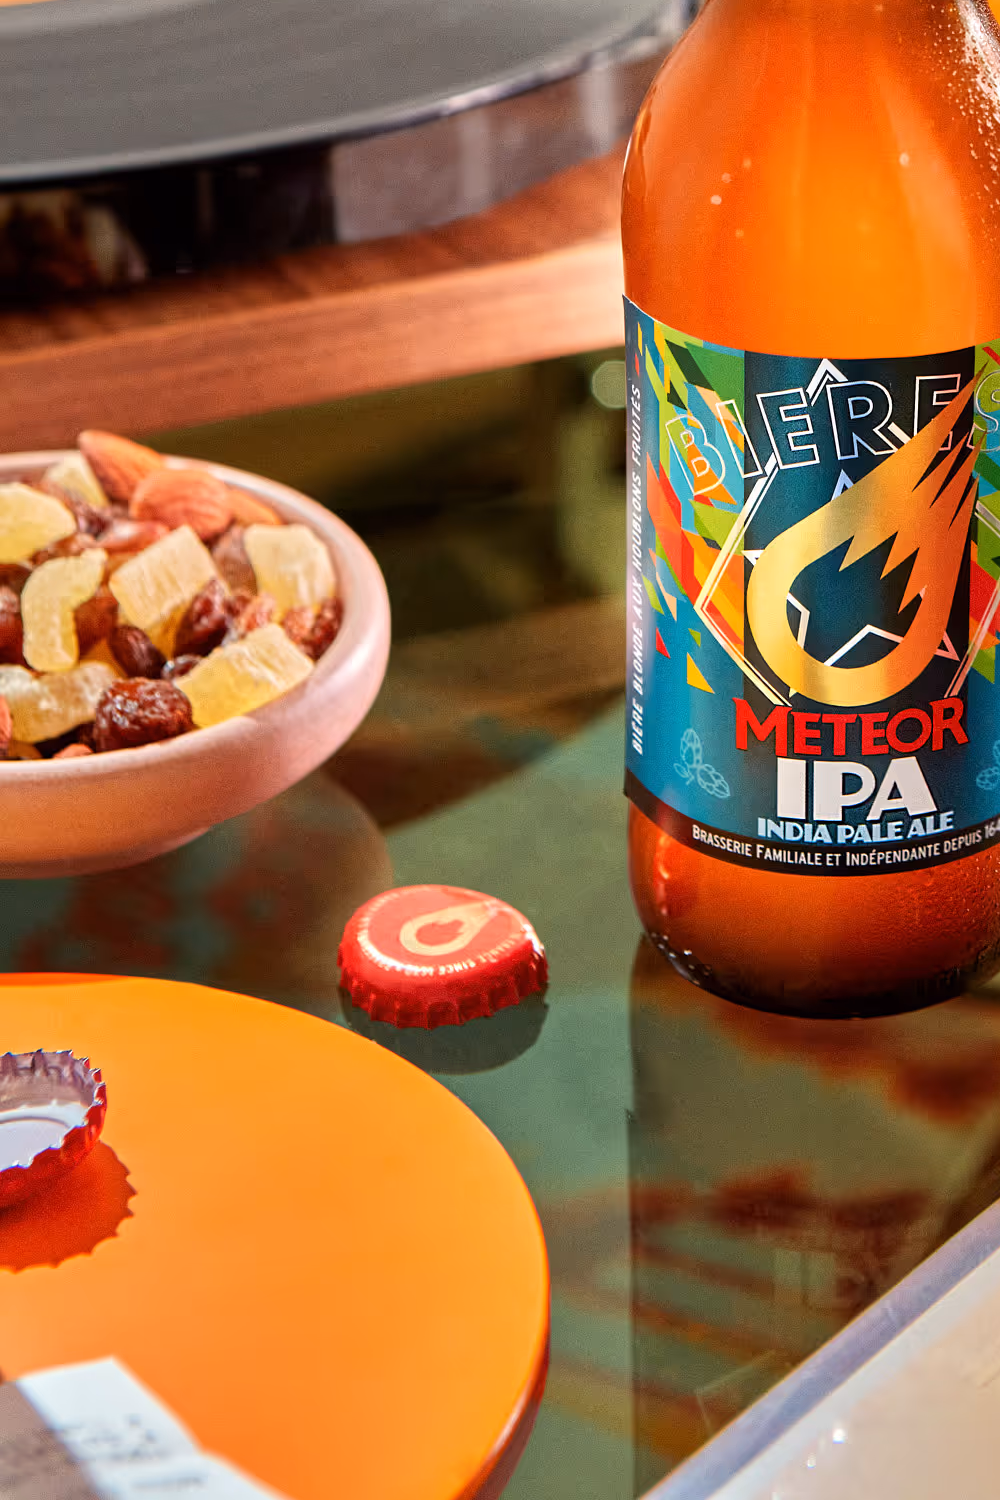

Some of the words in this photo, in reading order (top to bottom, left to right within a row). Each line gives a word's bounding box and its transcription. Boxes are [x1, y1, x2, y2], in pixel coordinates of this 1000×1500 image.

[631, 472, 643, 571] HOUBLONS
[632, 576, 643, 619] AUX
[632, 622, 644, 695] BLONDE
[732, 697, 969, 757] METEOR
[777, 755, 938, 822] IPA
[692, 824, 753, 857] BRASSERIE
[756, 844, 822, 866] FAMILIALE
[826, 853, 841, 866] ET
[846, 843, 941, 866] INDÉPENDANTE
[943, 830, 982, 854] DEPUIS
[757, 817, 833, 844] INDIA
[836, 821, 904, 844] PALE
[907, 811, 955, 839] ALE
